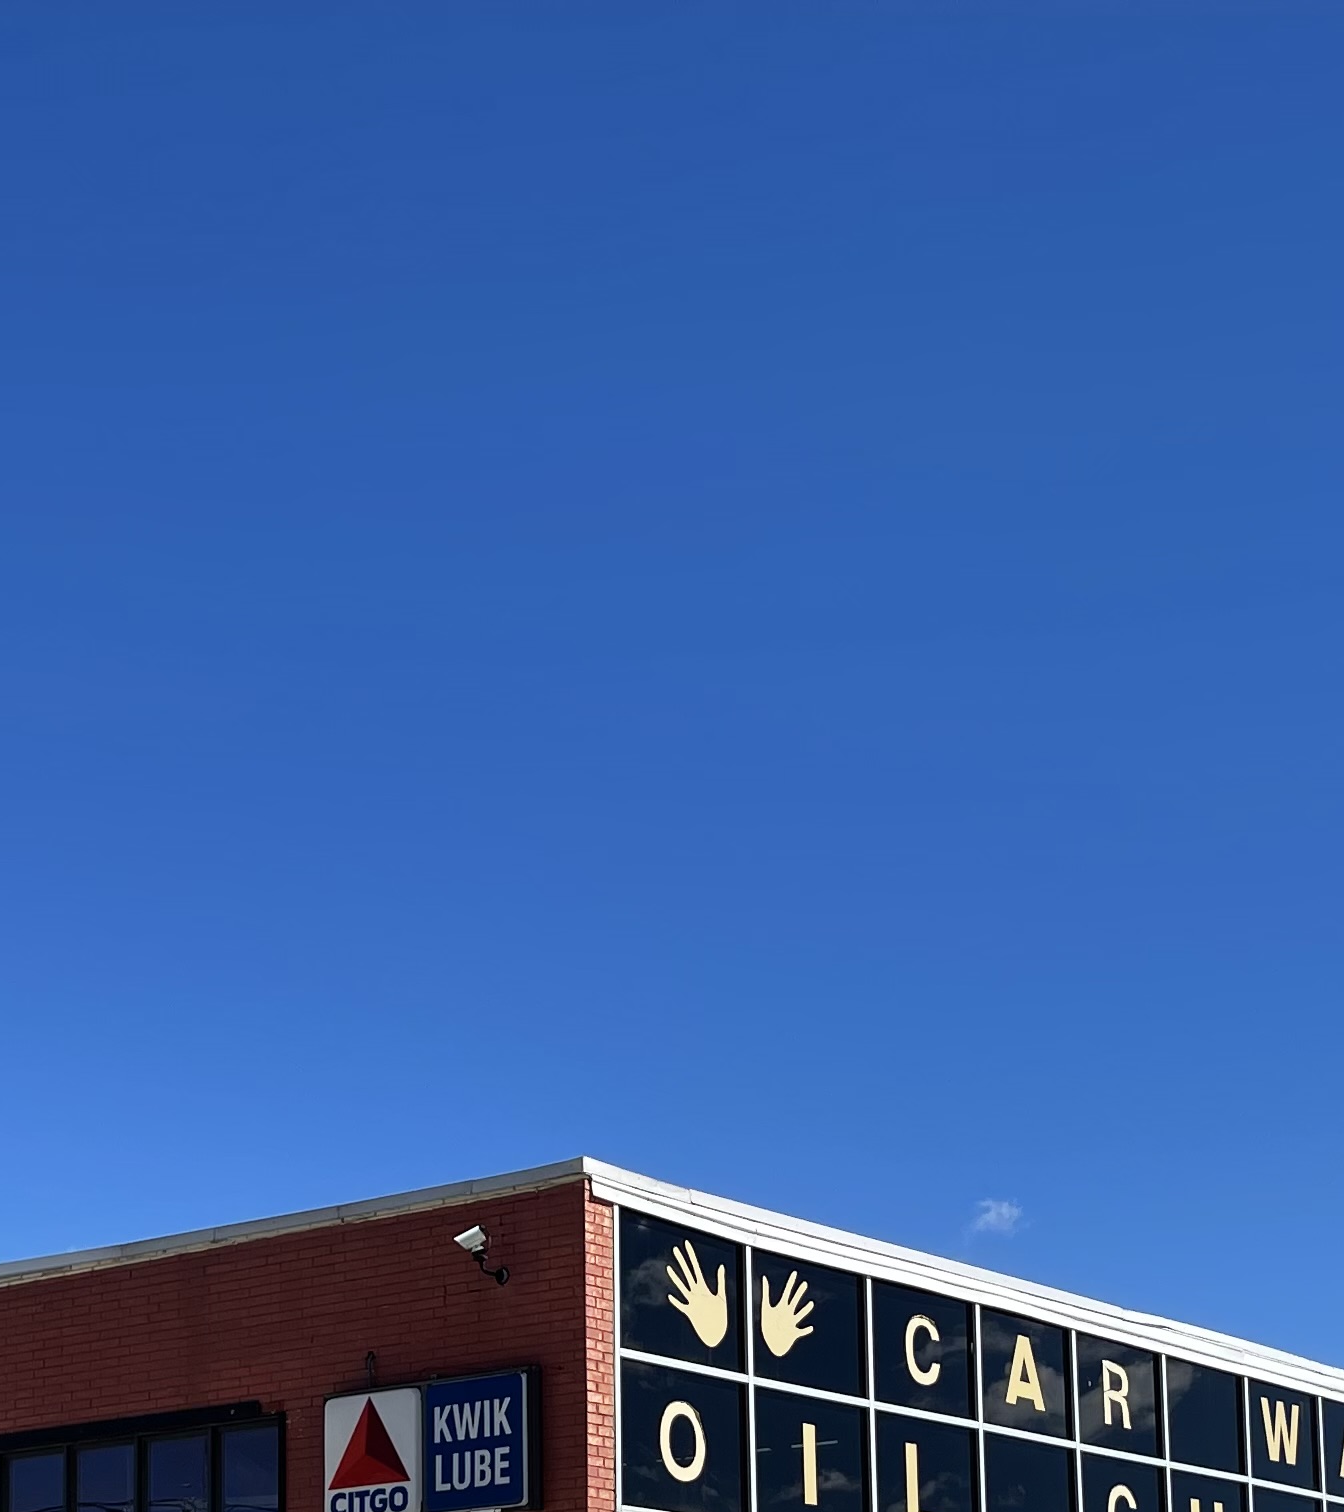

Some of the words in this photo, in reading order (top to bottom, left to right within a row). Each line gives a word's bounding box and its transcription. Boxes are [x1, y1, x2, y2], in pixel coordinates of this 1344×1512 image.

[905, 1314, 1132, 1430] CAR
[433, 1396, 512, 1444] KWIK
[435, 1446, 511, 1492] LUBE
